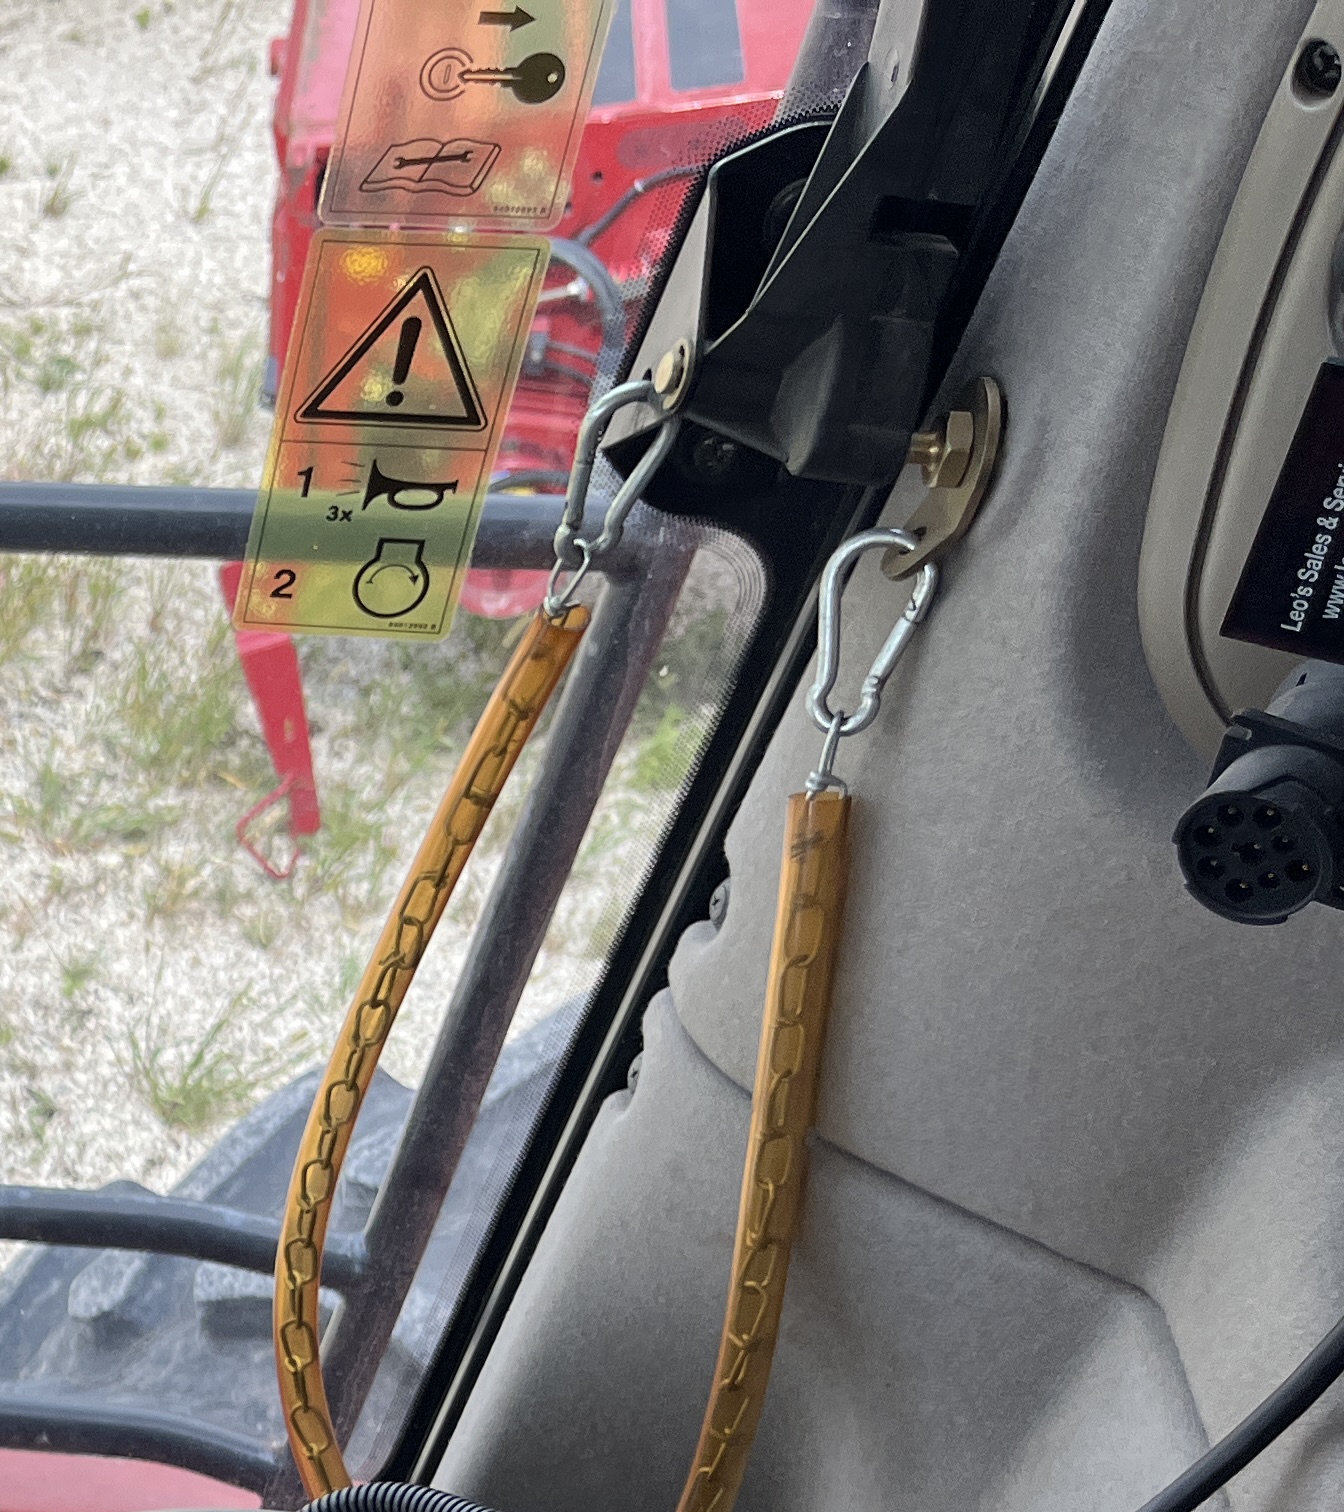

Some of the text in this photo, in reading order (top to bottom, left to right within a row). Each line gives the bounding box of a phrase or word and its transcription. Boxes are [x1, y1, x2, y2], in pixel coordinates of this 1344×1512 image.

[297, 466, 314, 498] 1
[326, 505, 353, 522] 3x
[269, 569, 296, 599] 2
[1280, 585, 1314, 632] Leo's
[1297, 533, 1332, 583] Sales
[1316, 516, 1340, 530] &
